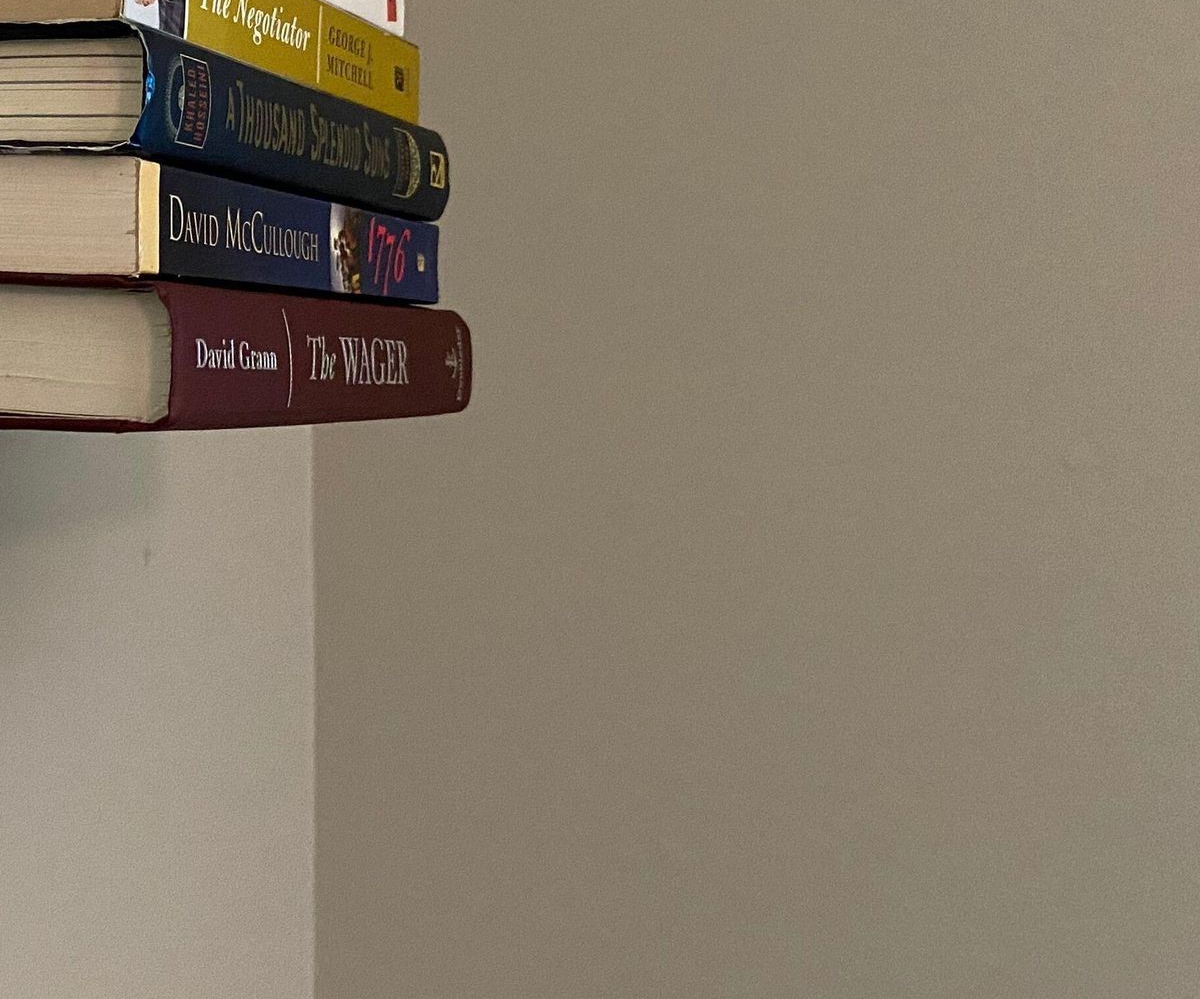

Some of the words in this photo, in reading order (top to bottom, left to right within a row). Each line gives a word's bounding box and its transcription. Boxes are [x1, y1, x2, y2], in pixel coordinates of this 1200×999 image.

[328, 25, 366, 59] GEORGE
[326, 54, 373, 90] MITCHELL
[184, 69, 197, 133] KHALED
[192, 64, 209, 144] HOSSEINI
[225, 86, 236, 132] A
[236, 79, 306, 156] THOUSAND
[310, 102, 362, 172] SPLENDID
[169, 194, 219, 247] DAVID
[368, 216, 411, 296] 1776
[195, 338, 235, 370] David
[239, 341, 278, 371] Grann
[306, 334, 336, 381] The
[338, 336, 409, 386] WAGER
